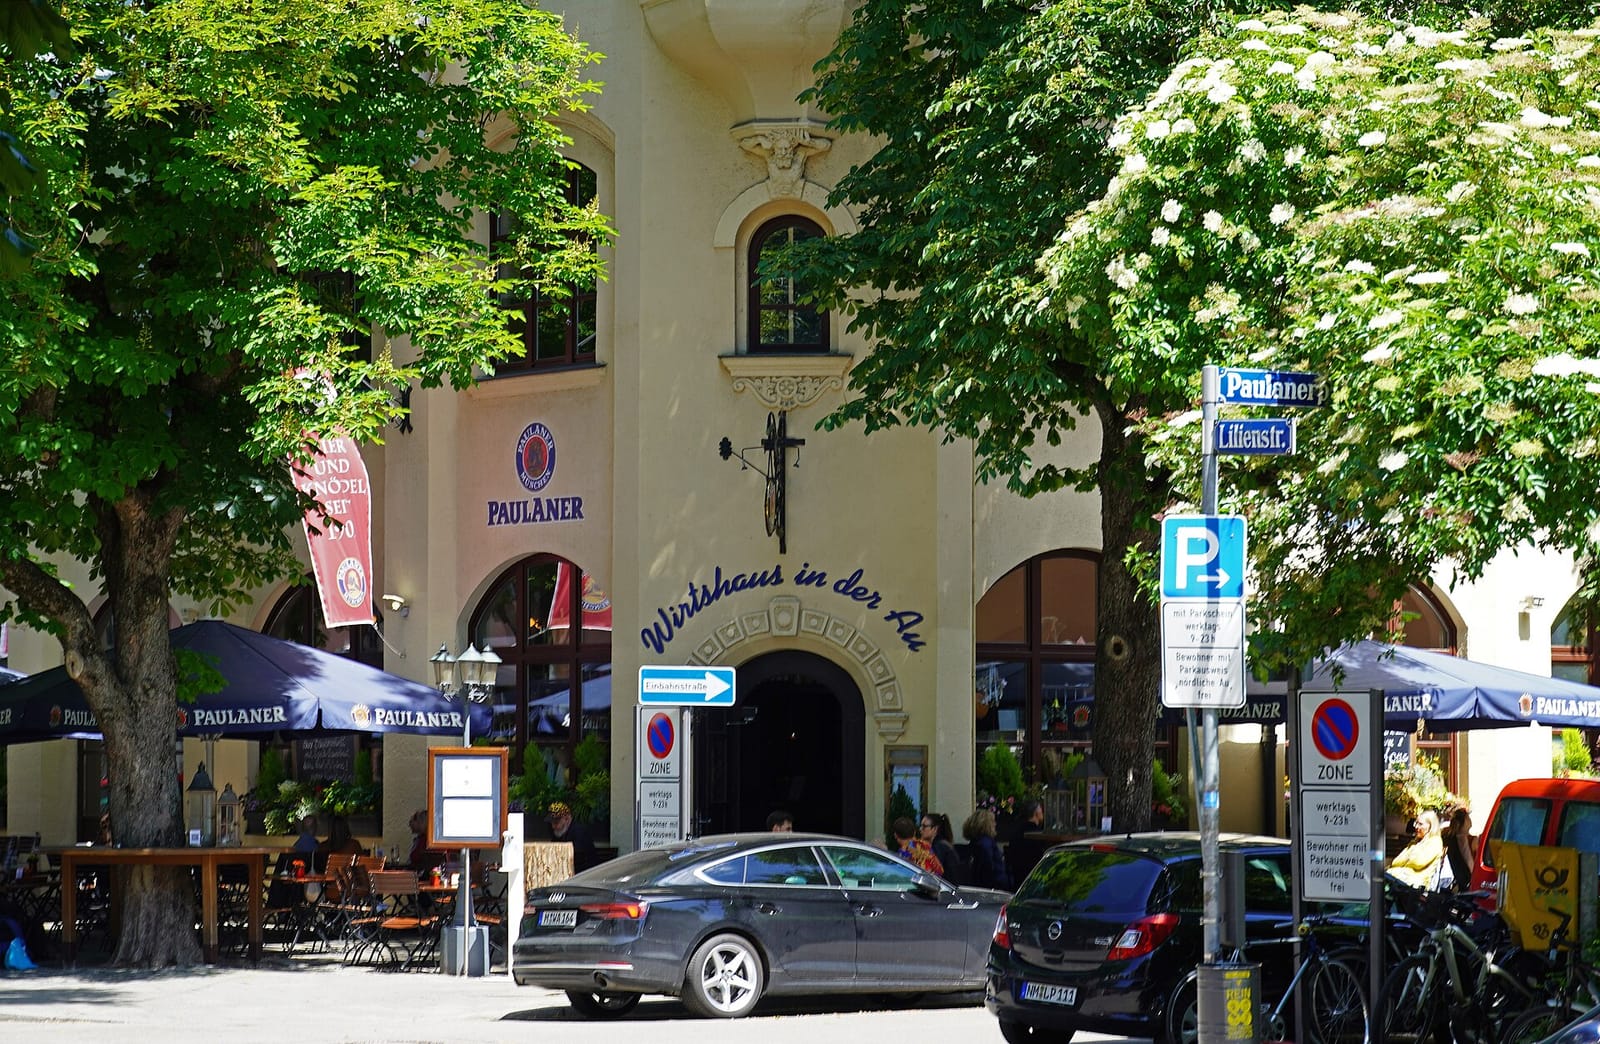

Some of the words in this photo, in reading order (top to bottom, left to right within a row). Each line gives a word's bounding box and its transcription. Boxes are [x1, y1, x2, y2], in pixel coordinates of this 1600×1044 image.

[517, 424, 555, 454] PAULANER
[1218, 423, 1287, 450] Lilienstr.
[313, 459, 350, 476] UND
[487, 496, 585, 526] PAULANER
[1175, 526, 1220, 590] P
[641, 564, 785, 654] Wirtshaus
[793, 562, 827, 587] in
[833, 568, 882, 610] der
[884, 609, 926, 652] Au
[1173, 609, 1186, 618] mit
[1189, 608, 1233, 618] Parkschein
[1185, 622, 1221, 633] werktags
[1176, 651, 1214, 661] Bewohner
[1218, 653, 1232, 661] mit
[1179, 664, 1229, 675] Parkausweis
[646, 681, 708, 691] Einbahnstraße
[1197, 690, 1212, 700] frei
[193, 705, 288, 727] PAULANER
[374, 708, 465, 728] PAULANER
[649, 762, 671, 775] ZONE
[1318, 764, 1354, 780] ZONE
[648, 790, 673, 801] werktags
[1315, 802, 1356, 815] werktags
[1306, 841, 1349, 852] Bewohner
[1352, 842, 1367, 852] mit
[1309, 854, 1364, 866] Parkausweis
[1309, 867, 1350, 879] nördliche
[1352, 869, 1365, 880] Au
[1330, 882, 1345, 893] frei
